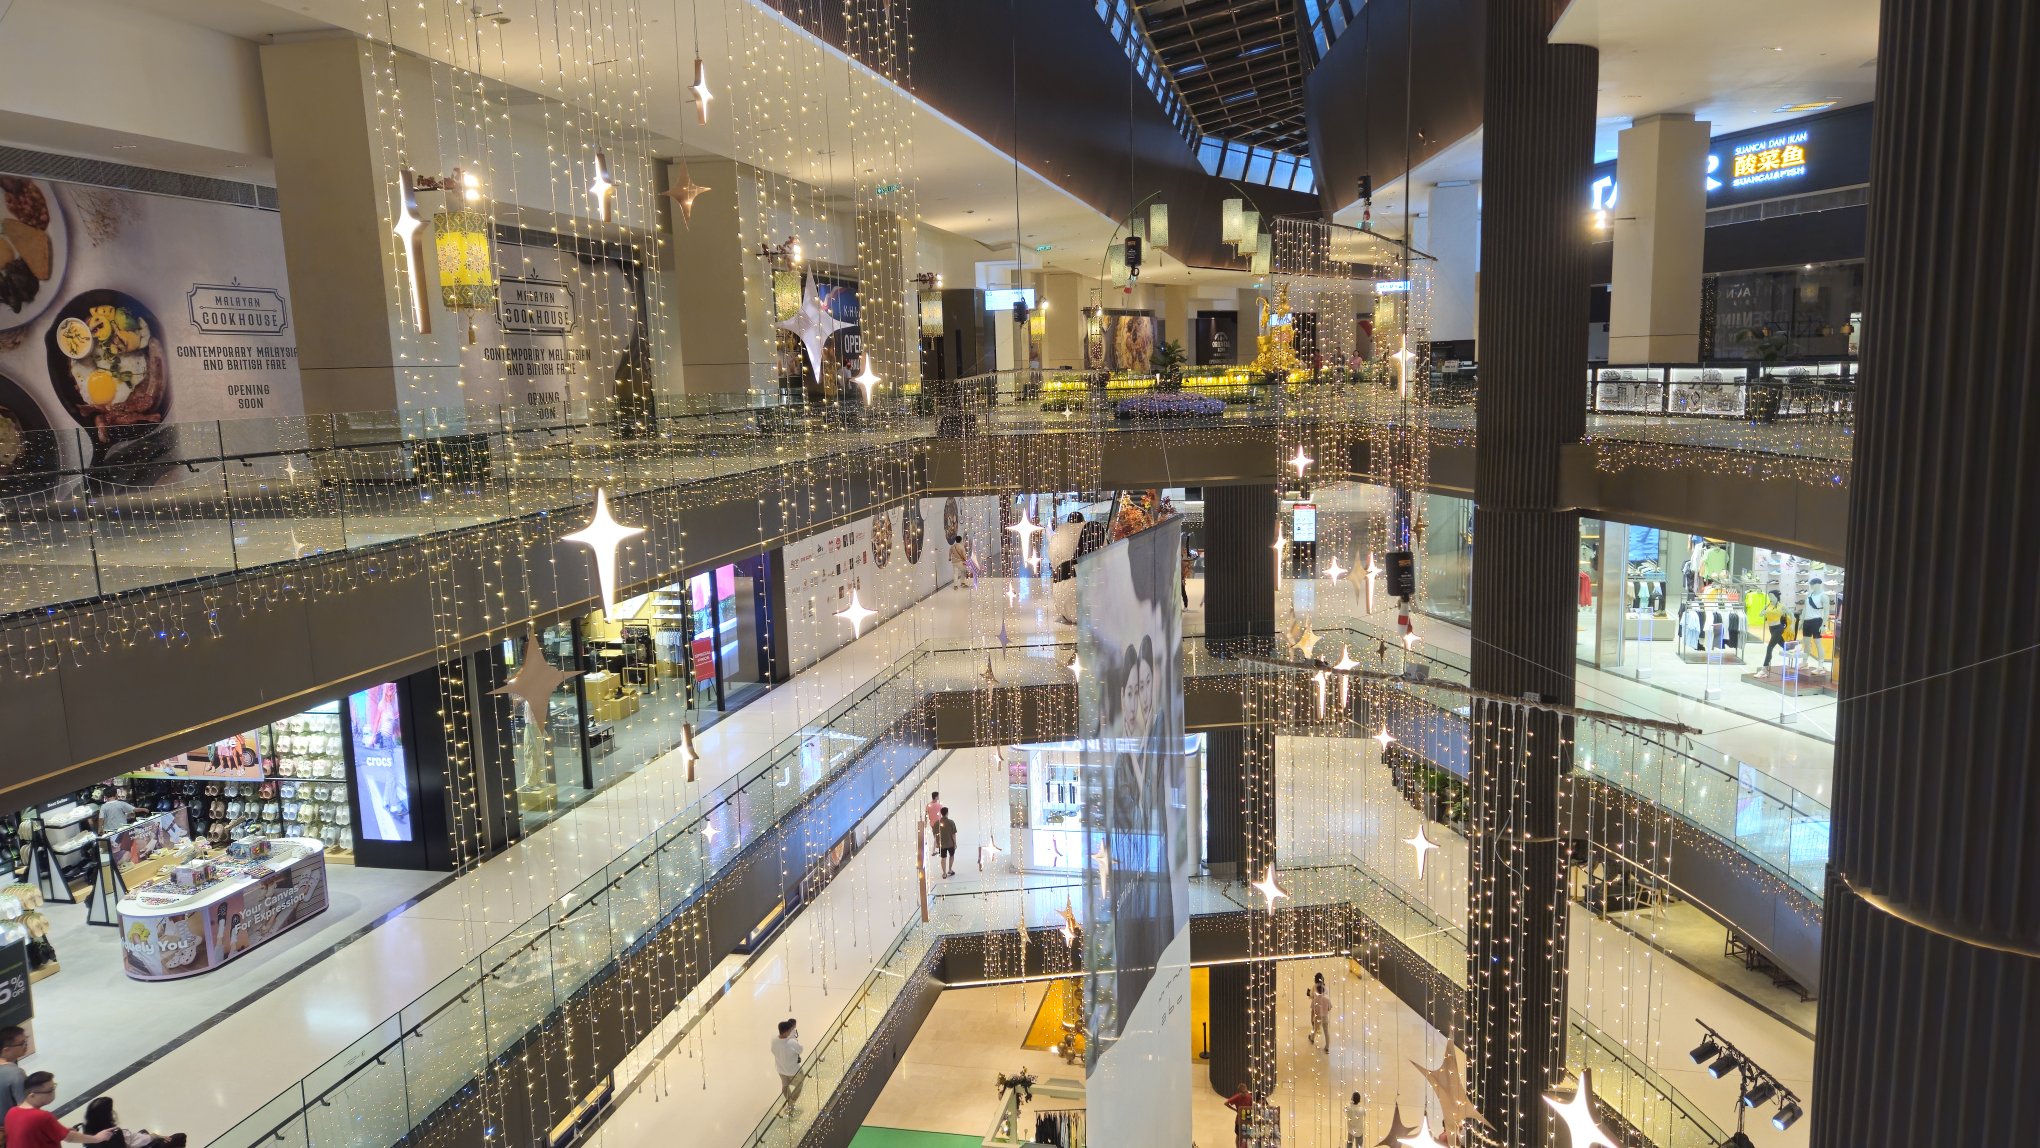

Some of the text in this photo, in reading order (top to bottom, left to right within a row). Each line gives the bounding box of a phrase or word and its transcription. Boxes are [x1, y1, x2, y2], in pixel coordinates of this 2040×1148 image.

[1734, 130, 1808, 155] SUANCAI DAN IKAN
[1733, 144, 1806, 178] 酸菜鱼
[215, 296, 261, 308] MALAYAN
[516, 289, 555, 303] MALAYAN
[202, 312, 278, 327] COOKHOUSE
[505, 308, 570, 326] COOKHOUSE
[176, 346, 298, 358] CONTEMPORARY MALAYSIA
[203, 359, 287, 371] AND BRITISH FARE
[507, 363, 524, 376] AND
[228, 384, 270, 396] OPENING
[238, 398, 264, 409] SOON
[366, 756, 392, 768] crocs
[239, 885, 300, 919] Your Canvas
[234, 893, 306, 934] For Expression
[157, 940, 189, 952] You
[12, 986, 26, 998] OFF
